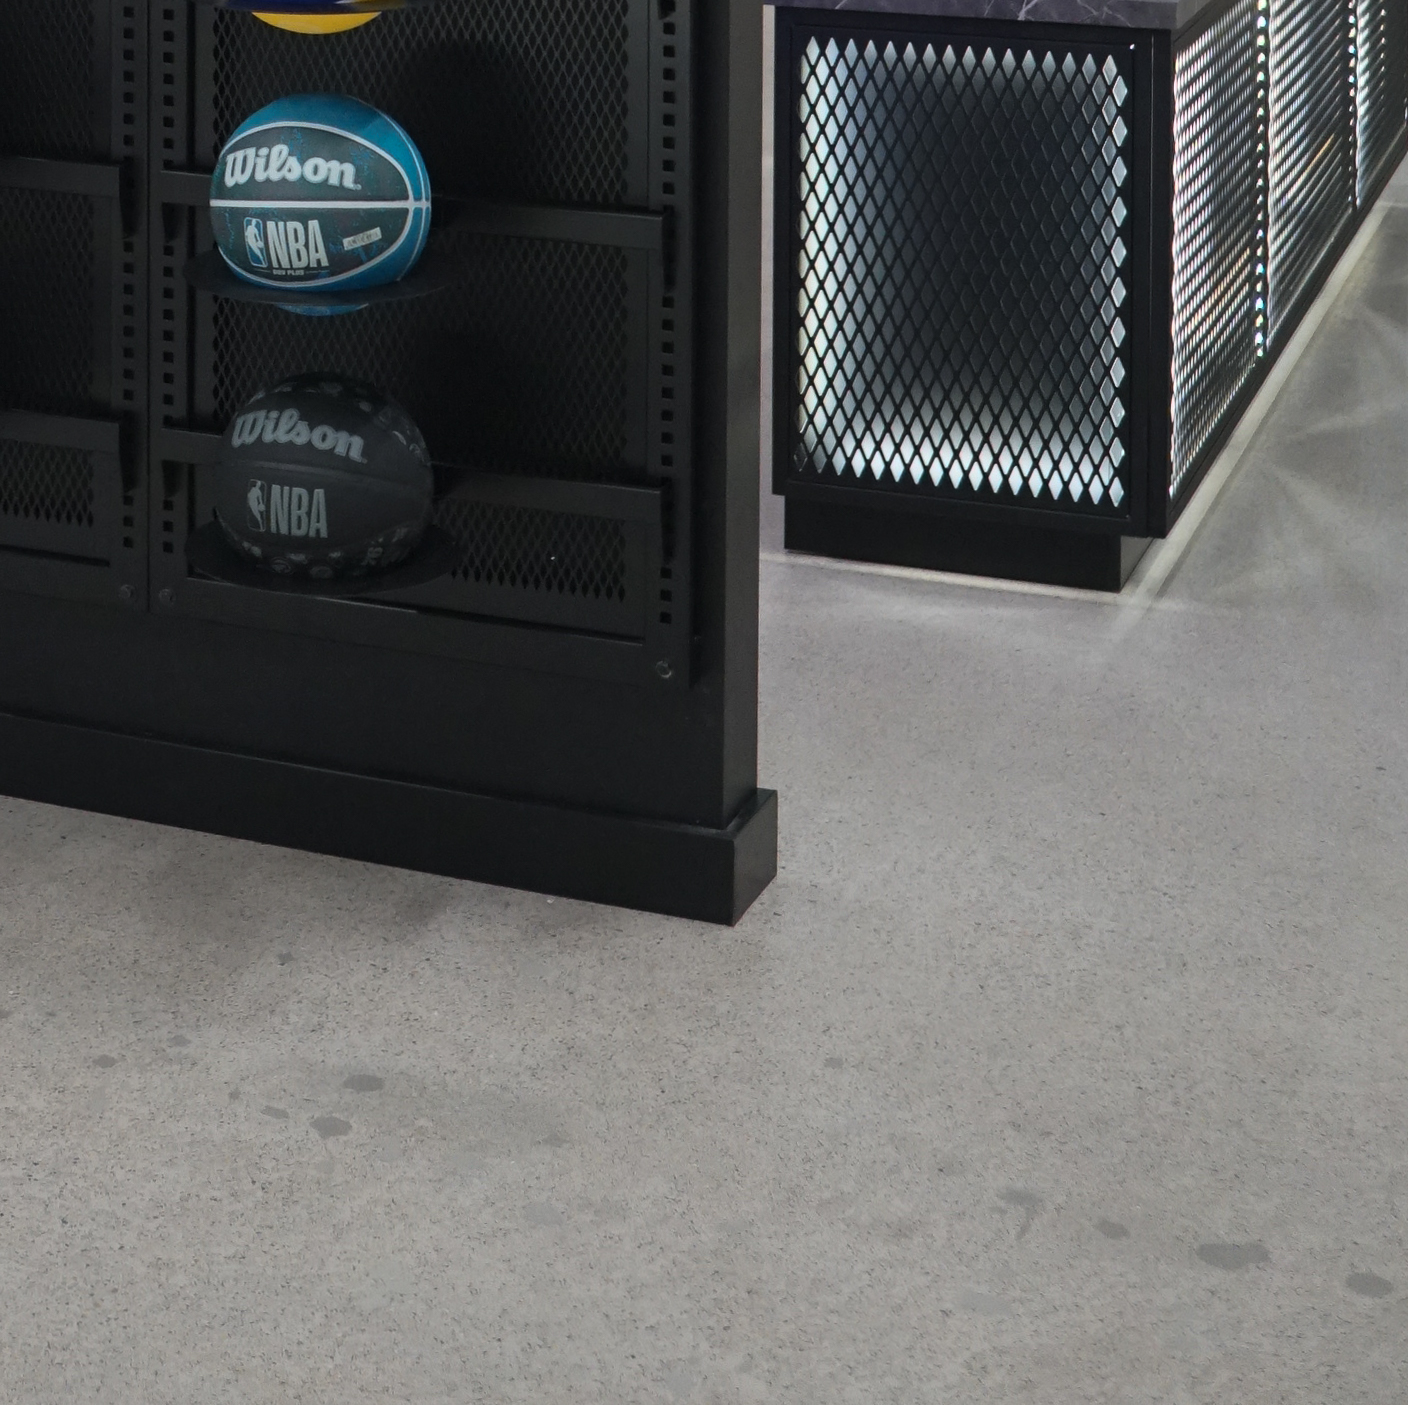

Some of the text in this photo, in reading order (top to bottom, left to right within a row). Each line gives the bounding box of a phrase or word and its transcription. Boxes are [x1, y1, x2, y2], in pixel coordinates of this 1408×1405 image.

[224, 144, 356, 190] Wilson
[266, 220, 329, 268] NBA
[231, 407, 366, 462] Wilson
[270, 485, 328, 538] NBA
